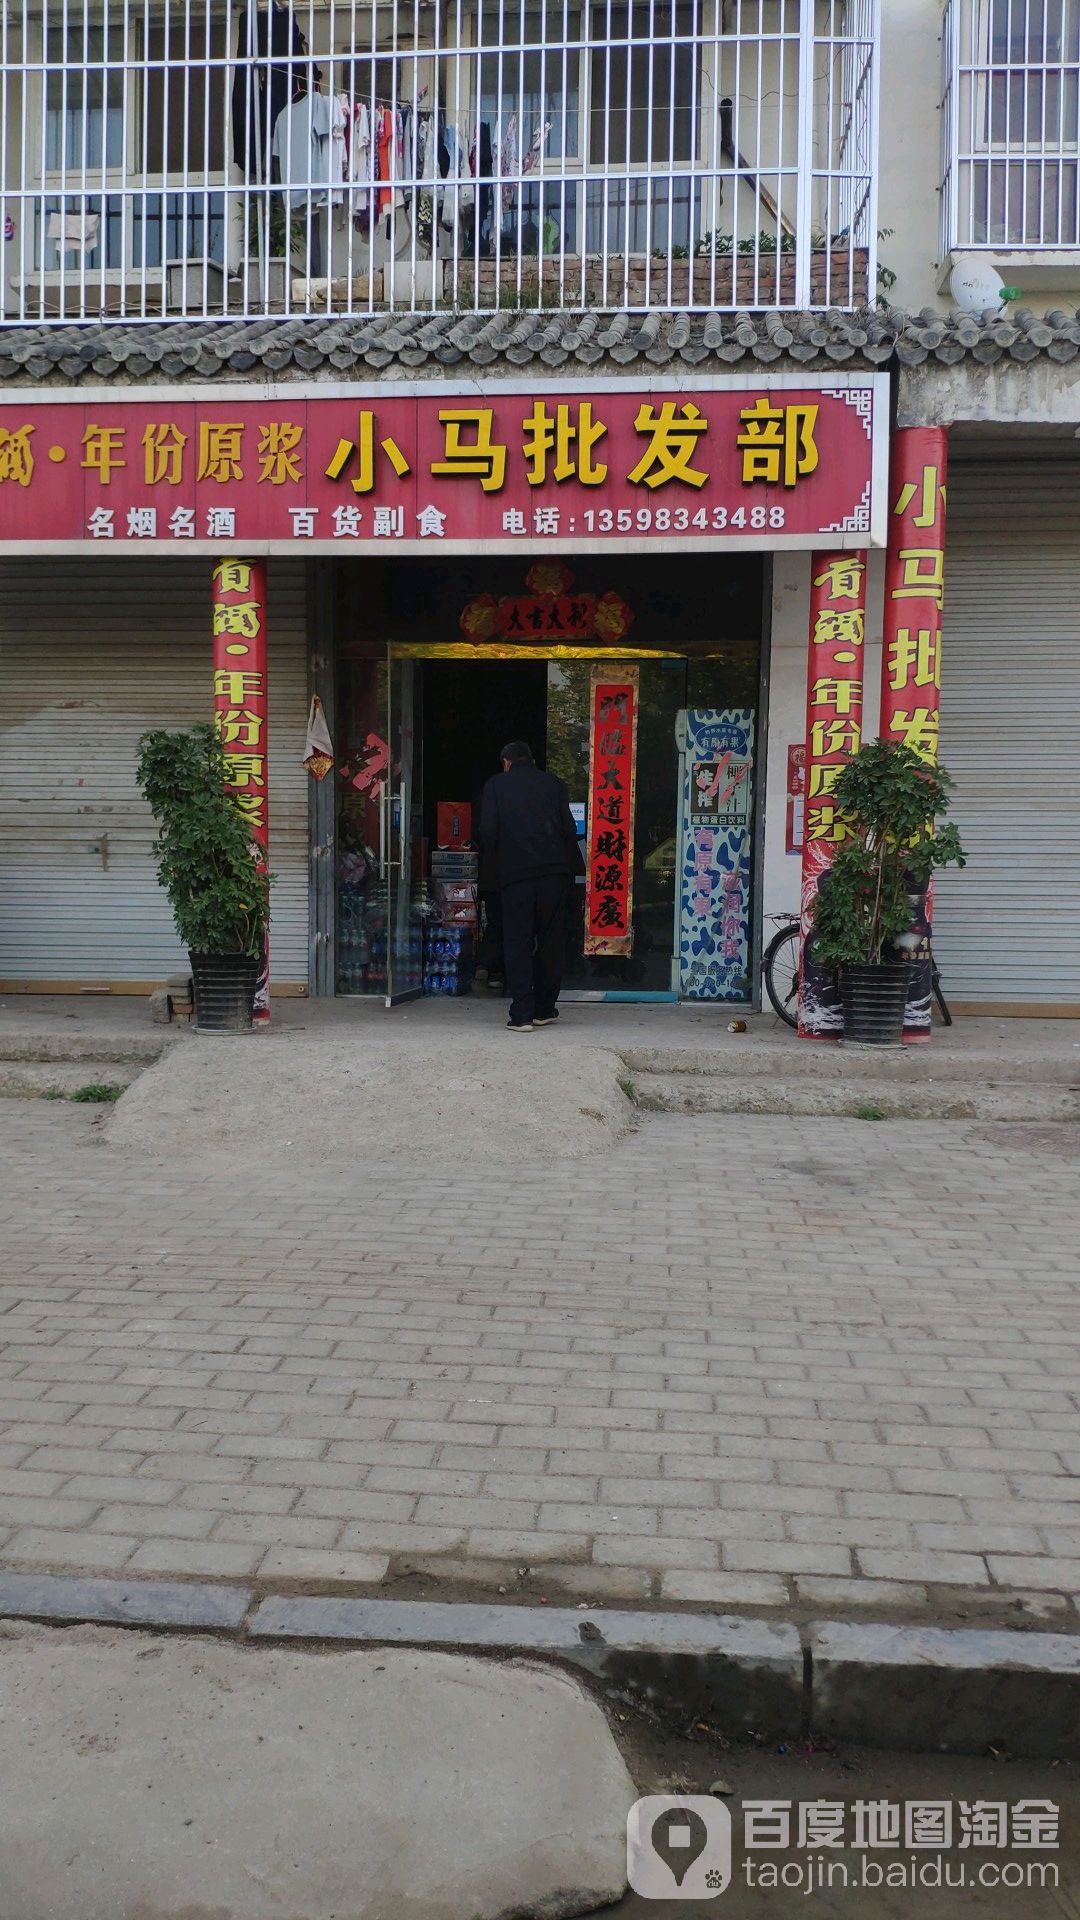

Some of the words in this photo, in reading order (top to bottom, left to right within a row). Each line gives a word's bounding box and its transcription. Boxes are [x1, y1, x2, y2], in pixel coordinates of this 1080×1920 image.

[325, 398, 820, 496] 小马批发部
[87, 507, 236, 538] 名烟名酒
[288, 505, 447, 538] 百货副食
[889, 465, 947, 848] 小马批发
